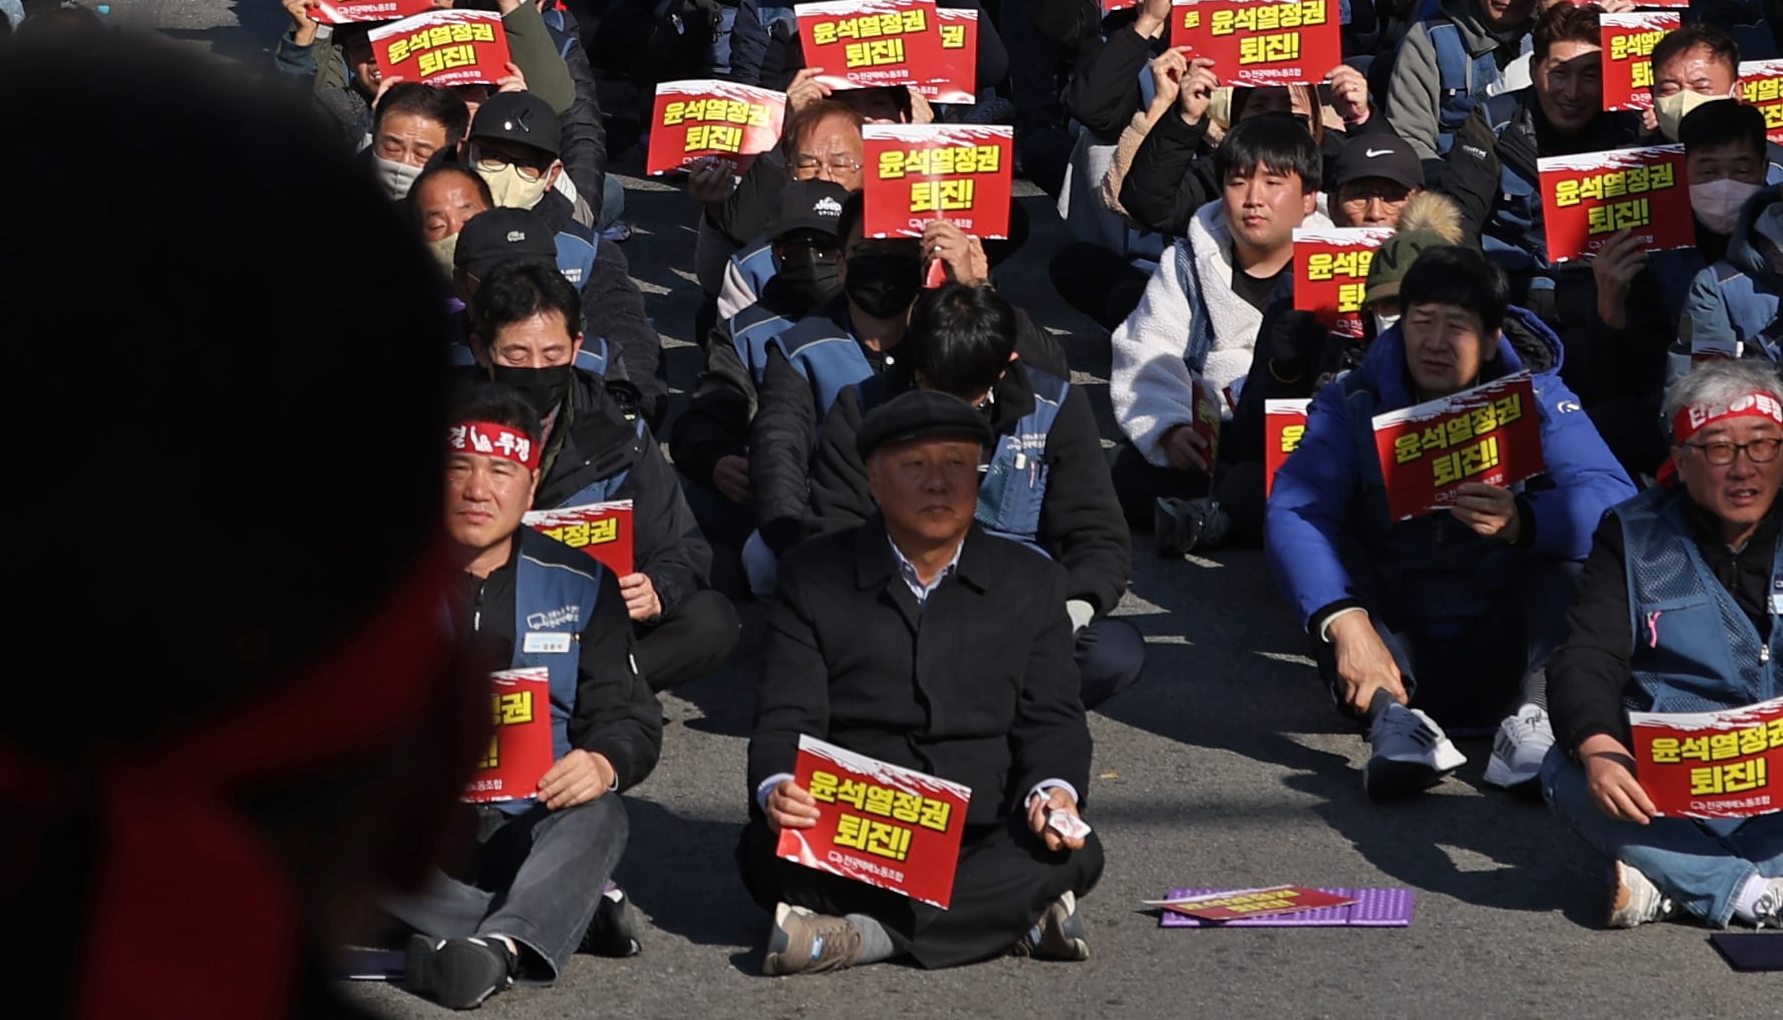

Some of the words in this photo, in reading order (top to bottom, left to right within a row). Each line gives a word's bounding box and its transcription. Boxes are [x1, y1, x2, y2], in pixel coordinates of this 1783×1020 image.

[813, 9, 927, 45] 윤석열정권
[1211, 0, 1327, 35] 윤석열정권
[845, 38, 905, 68] 퇴진!
[1239, 32, 1301, 65] 퇴진!
[879, 145, 1001, 179] 윤석열정권
[910, 179, 975, 212] 퇴진!
[1556, 162, 1674, 207] 윤석열정권
[1589, 197, 1648, 234] 퇴진!
[1395, 393, 1521, 463] 윤석열정권
[493, 431, 531, 462] 투쟁
[1432, 437, 1499, 487] 퇴진!
[1690, 757, 1767, 796] 퇴진!
[808, 771, 951, 832] 윤석열정권
[833, 813, 913, 861] 퇴진!
